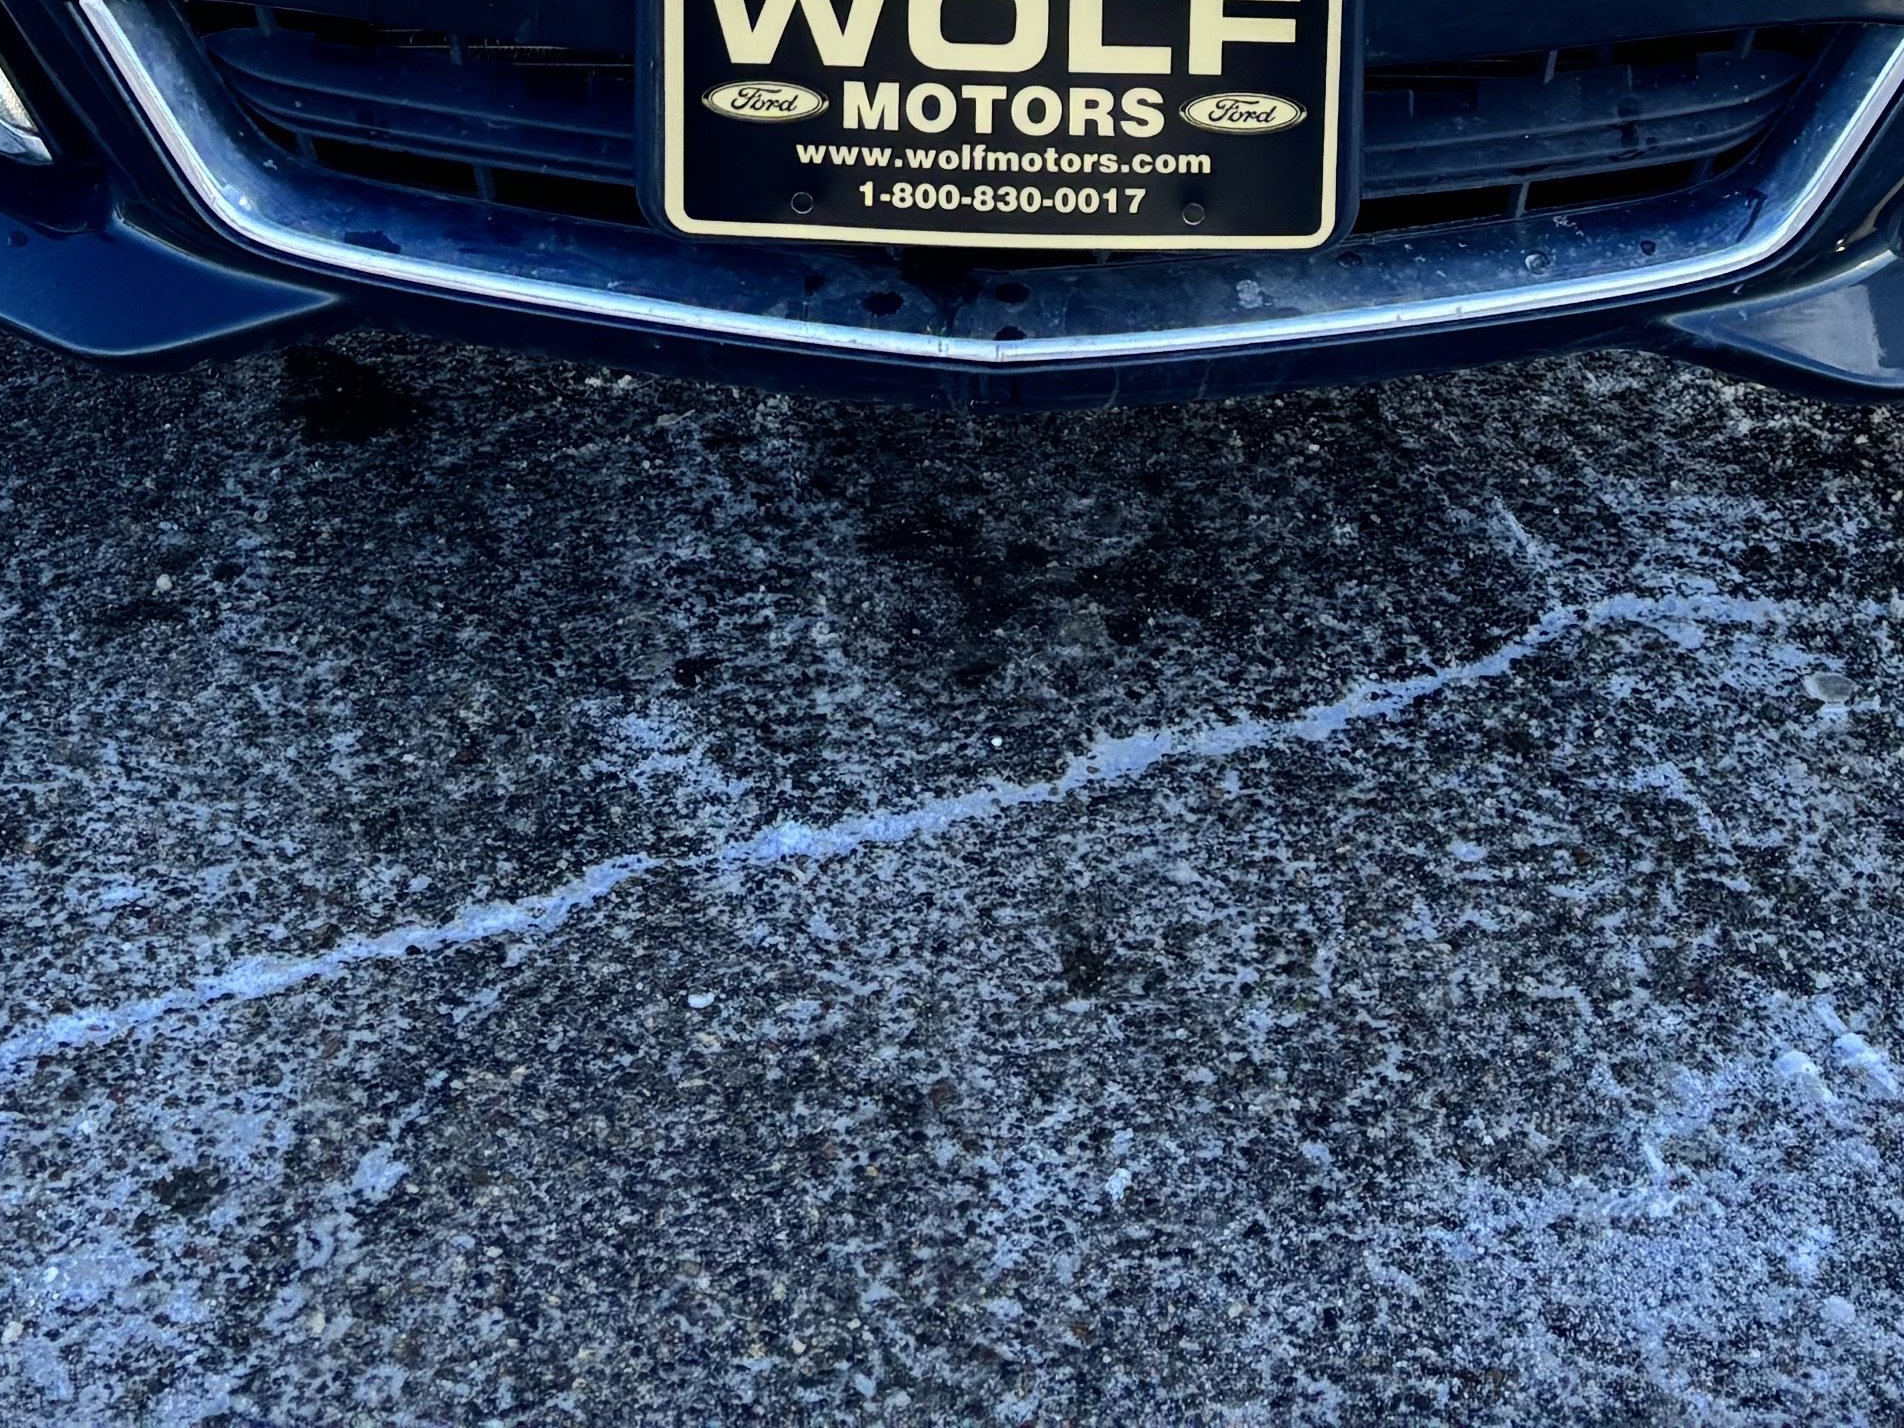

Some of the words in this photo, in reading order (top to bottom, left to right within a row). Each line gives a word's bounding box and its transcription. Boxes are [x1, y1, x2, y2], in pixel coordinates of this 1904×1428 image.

[841, 80, 1166, 139] MOTORS
[795, 142, 1213, 175] www.wolfmotors.com
[858, 181, 1147, 215] 1-800-830-0017
